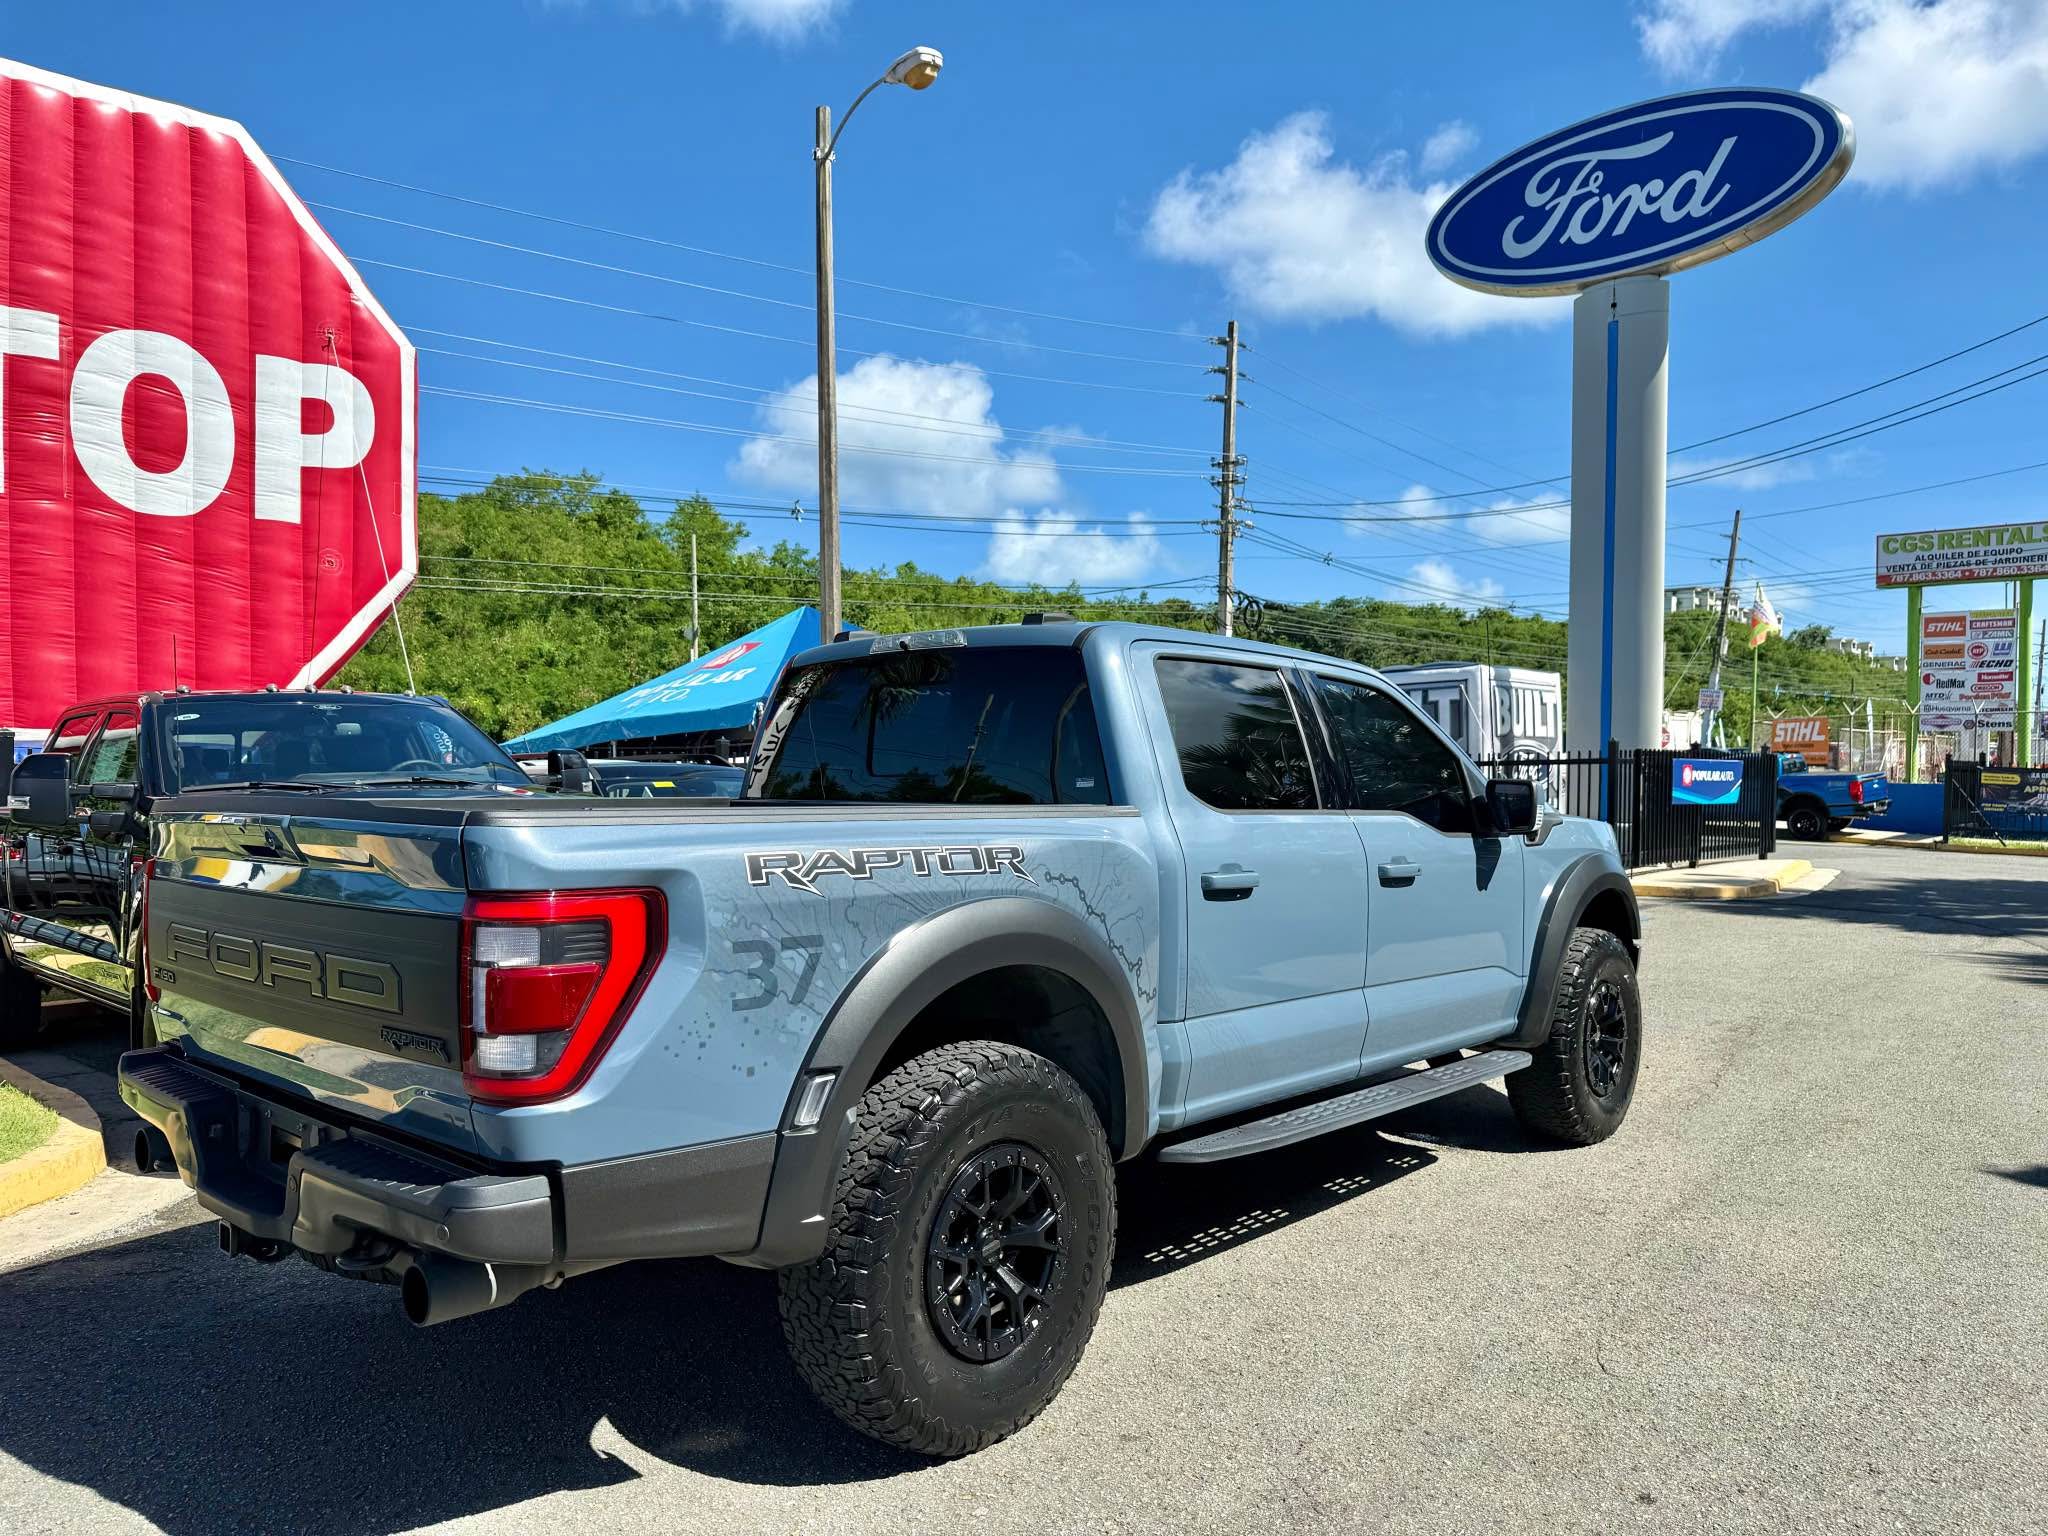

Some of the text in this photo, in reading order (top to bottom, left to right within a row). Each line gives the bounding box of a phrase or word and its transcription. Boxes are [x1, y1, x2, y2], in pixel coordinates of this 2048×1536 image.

[1502, 130, 1738, 259] Ford
[1882, 535, 1935, 554] CGS
[1914, 547, 2023, 562] ALQUILER DE EQUIPO
[1886, 564, 1916, 573] VENTA
[1920, 562, 1933, 570] DE
[1936, 559, 1972, 569] PIEZAS
[1975, 558, 1988, 566] DE
[1926, 622, 1963, 633] STIHL
[1972, 620, 2013, 628] CRAFTSMAN
[1979, 660, 2014, 668] ECHO
[1936, 679, 1966, 689] RedMax
[1494, 684, 1557, 738] BUILT
[1931, 704, 1971, 712] Husqvarna
[1775, 720, 1826, 742] STIHL
[1978, 720, 2012, 728] Stens
[1692, 769, 1721, 781] POPULAR
[744, 844, 1041, 899] RAPTOR
[166, 921, 403, 1015] FORD
[732, 934, 824, 1012] 37
[380, 1026, 451, 1062] RAPTOR
